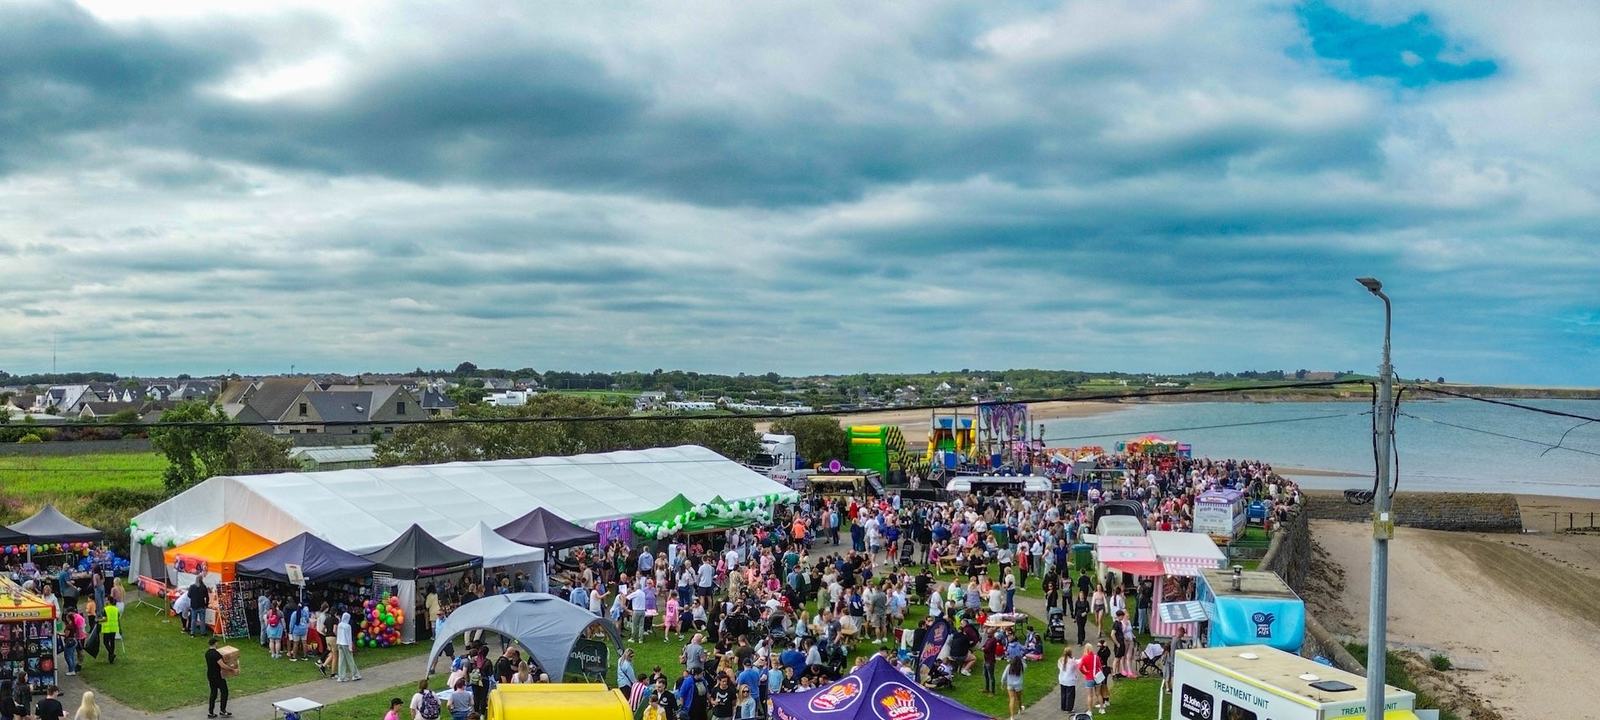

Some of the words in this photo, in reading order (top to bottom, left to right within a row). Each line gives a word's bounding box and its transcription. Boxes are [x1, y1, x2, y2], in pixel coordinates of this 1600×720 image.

[1213, 680, 1252, 702] TREATMENT
[1253, 696, 1270, 709] UNIT
[1189, 696, 1201, 708] John
[1341, 706, 1367, 716] TREAT
